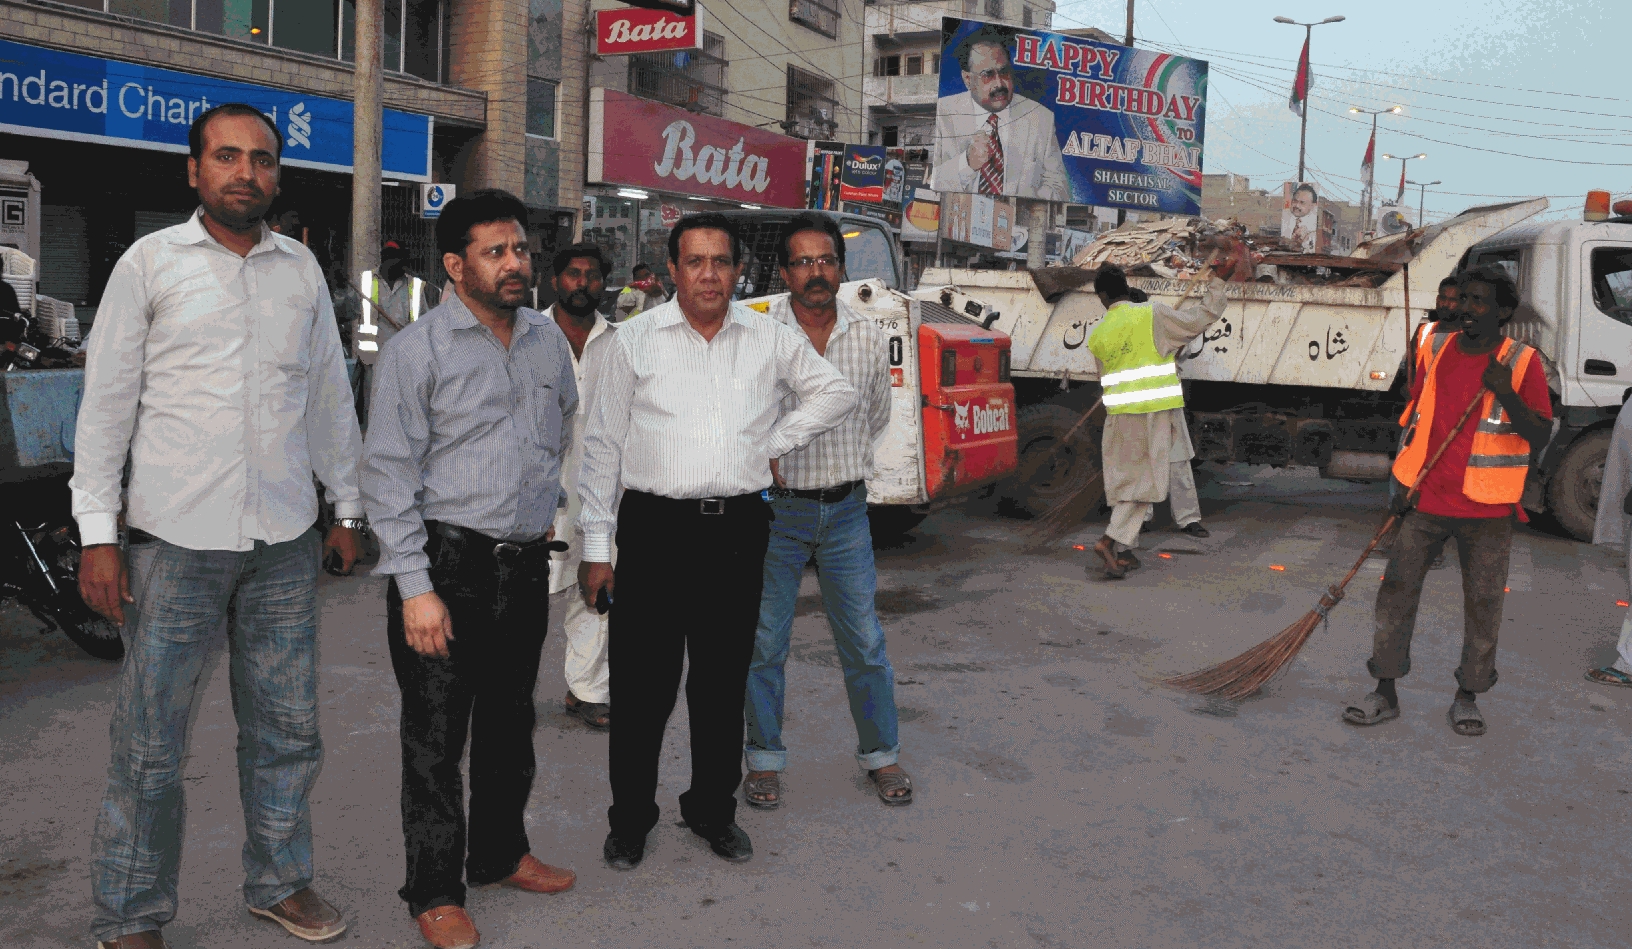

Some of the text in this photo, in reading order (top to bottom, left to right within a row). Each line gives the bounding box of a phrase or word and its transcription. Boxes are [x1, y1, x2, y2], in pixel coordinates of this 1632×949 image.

[605, 16, 688, 44] Bata
[1014, 34, 1119, 78] HAPPY
[1056, 75, 1200, 122] BIRTHDAY
[1176, 127, 1194, 142] TO
[654, 120, 771, 193] Bata
[851, 160, 878, 171] Dulux
[1062, 131, 1201, 170] ALTAF BHAI
[1094, 169, 1170, 190] SHAHFAISAL
[1108, 189, 1158, 206] SECTOR
[973, 402, 1010, 434] Bobcat
